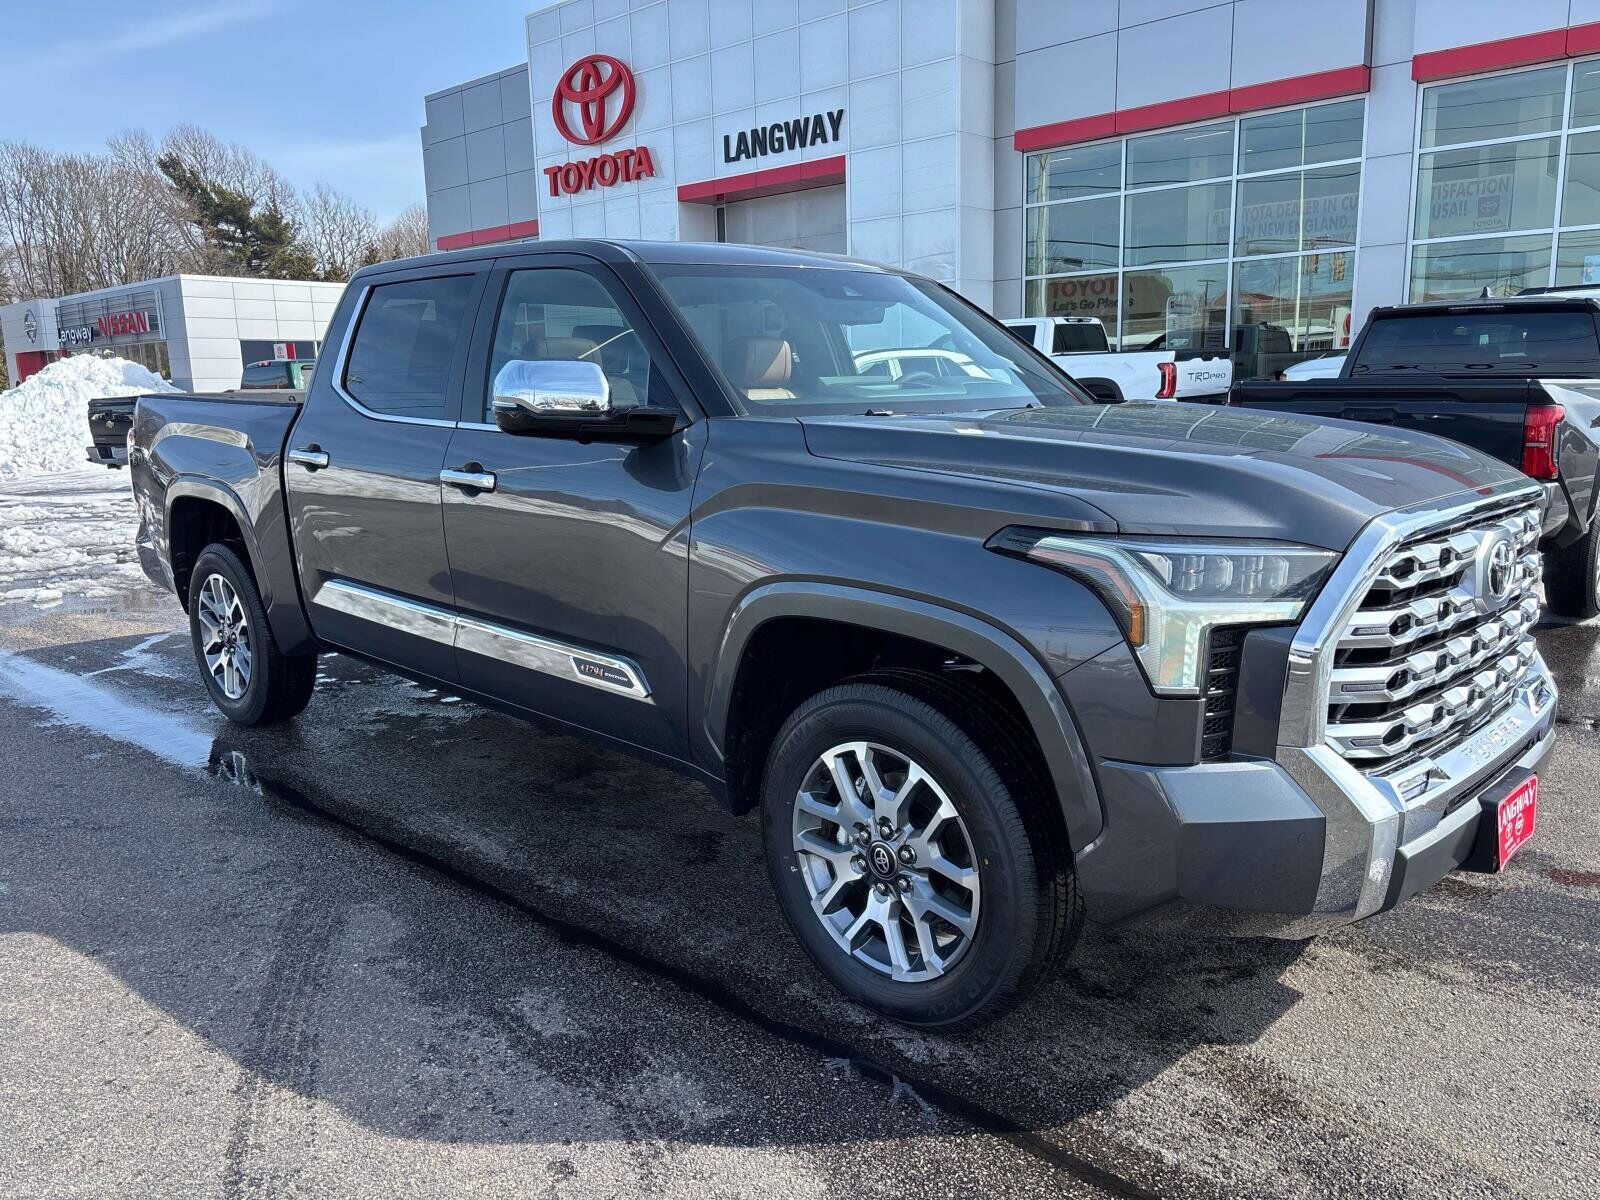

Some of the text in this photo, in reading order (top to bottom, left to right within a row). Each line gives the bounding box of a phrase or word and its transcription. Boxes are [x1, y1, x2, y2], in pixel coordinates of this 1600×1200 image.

[724, 109, 844, 163] LANGWAY
[544, 146, 655, 197] TOYOTA
[1079, 298, 1095, 310] Go
[97, 311, 150, 337] NISSAN
[1188, 372, 1226, 383] TRD PRO
